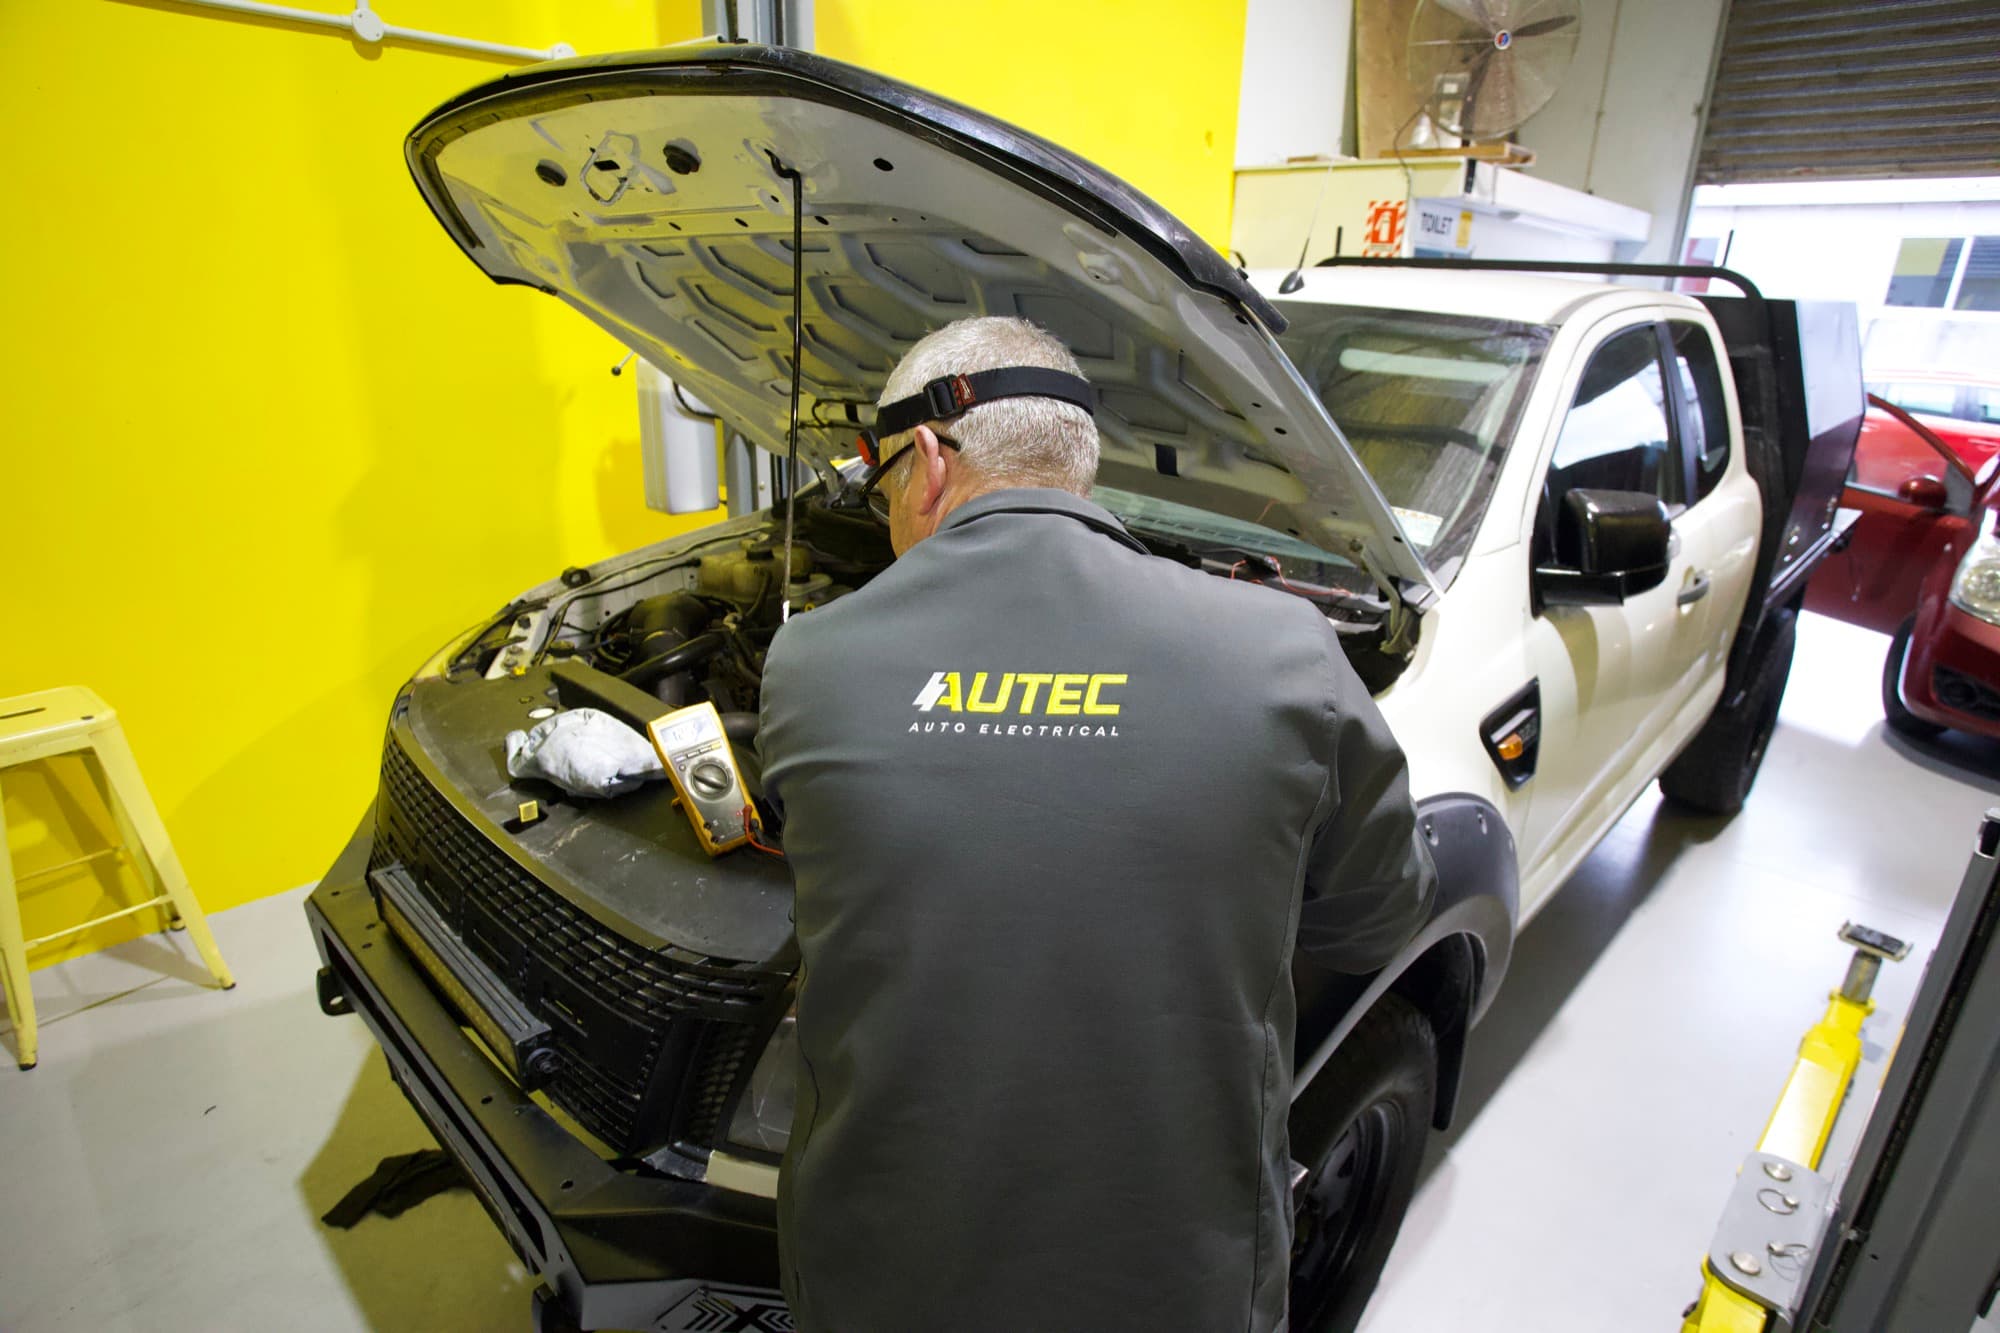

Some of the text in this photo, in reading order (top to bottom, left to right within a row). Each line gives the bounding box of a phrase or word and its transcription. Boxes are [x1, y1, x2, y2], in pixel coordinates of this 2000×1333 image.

[1421, 211, 1453, 235] TOILET
[912, 672, 1128, 715] AUTEC
[908, 722, 1120, 737] AUTO ELECTRICAL
